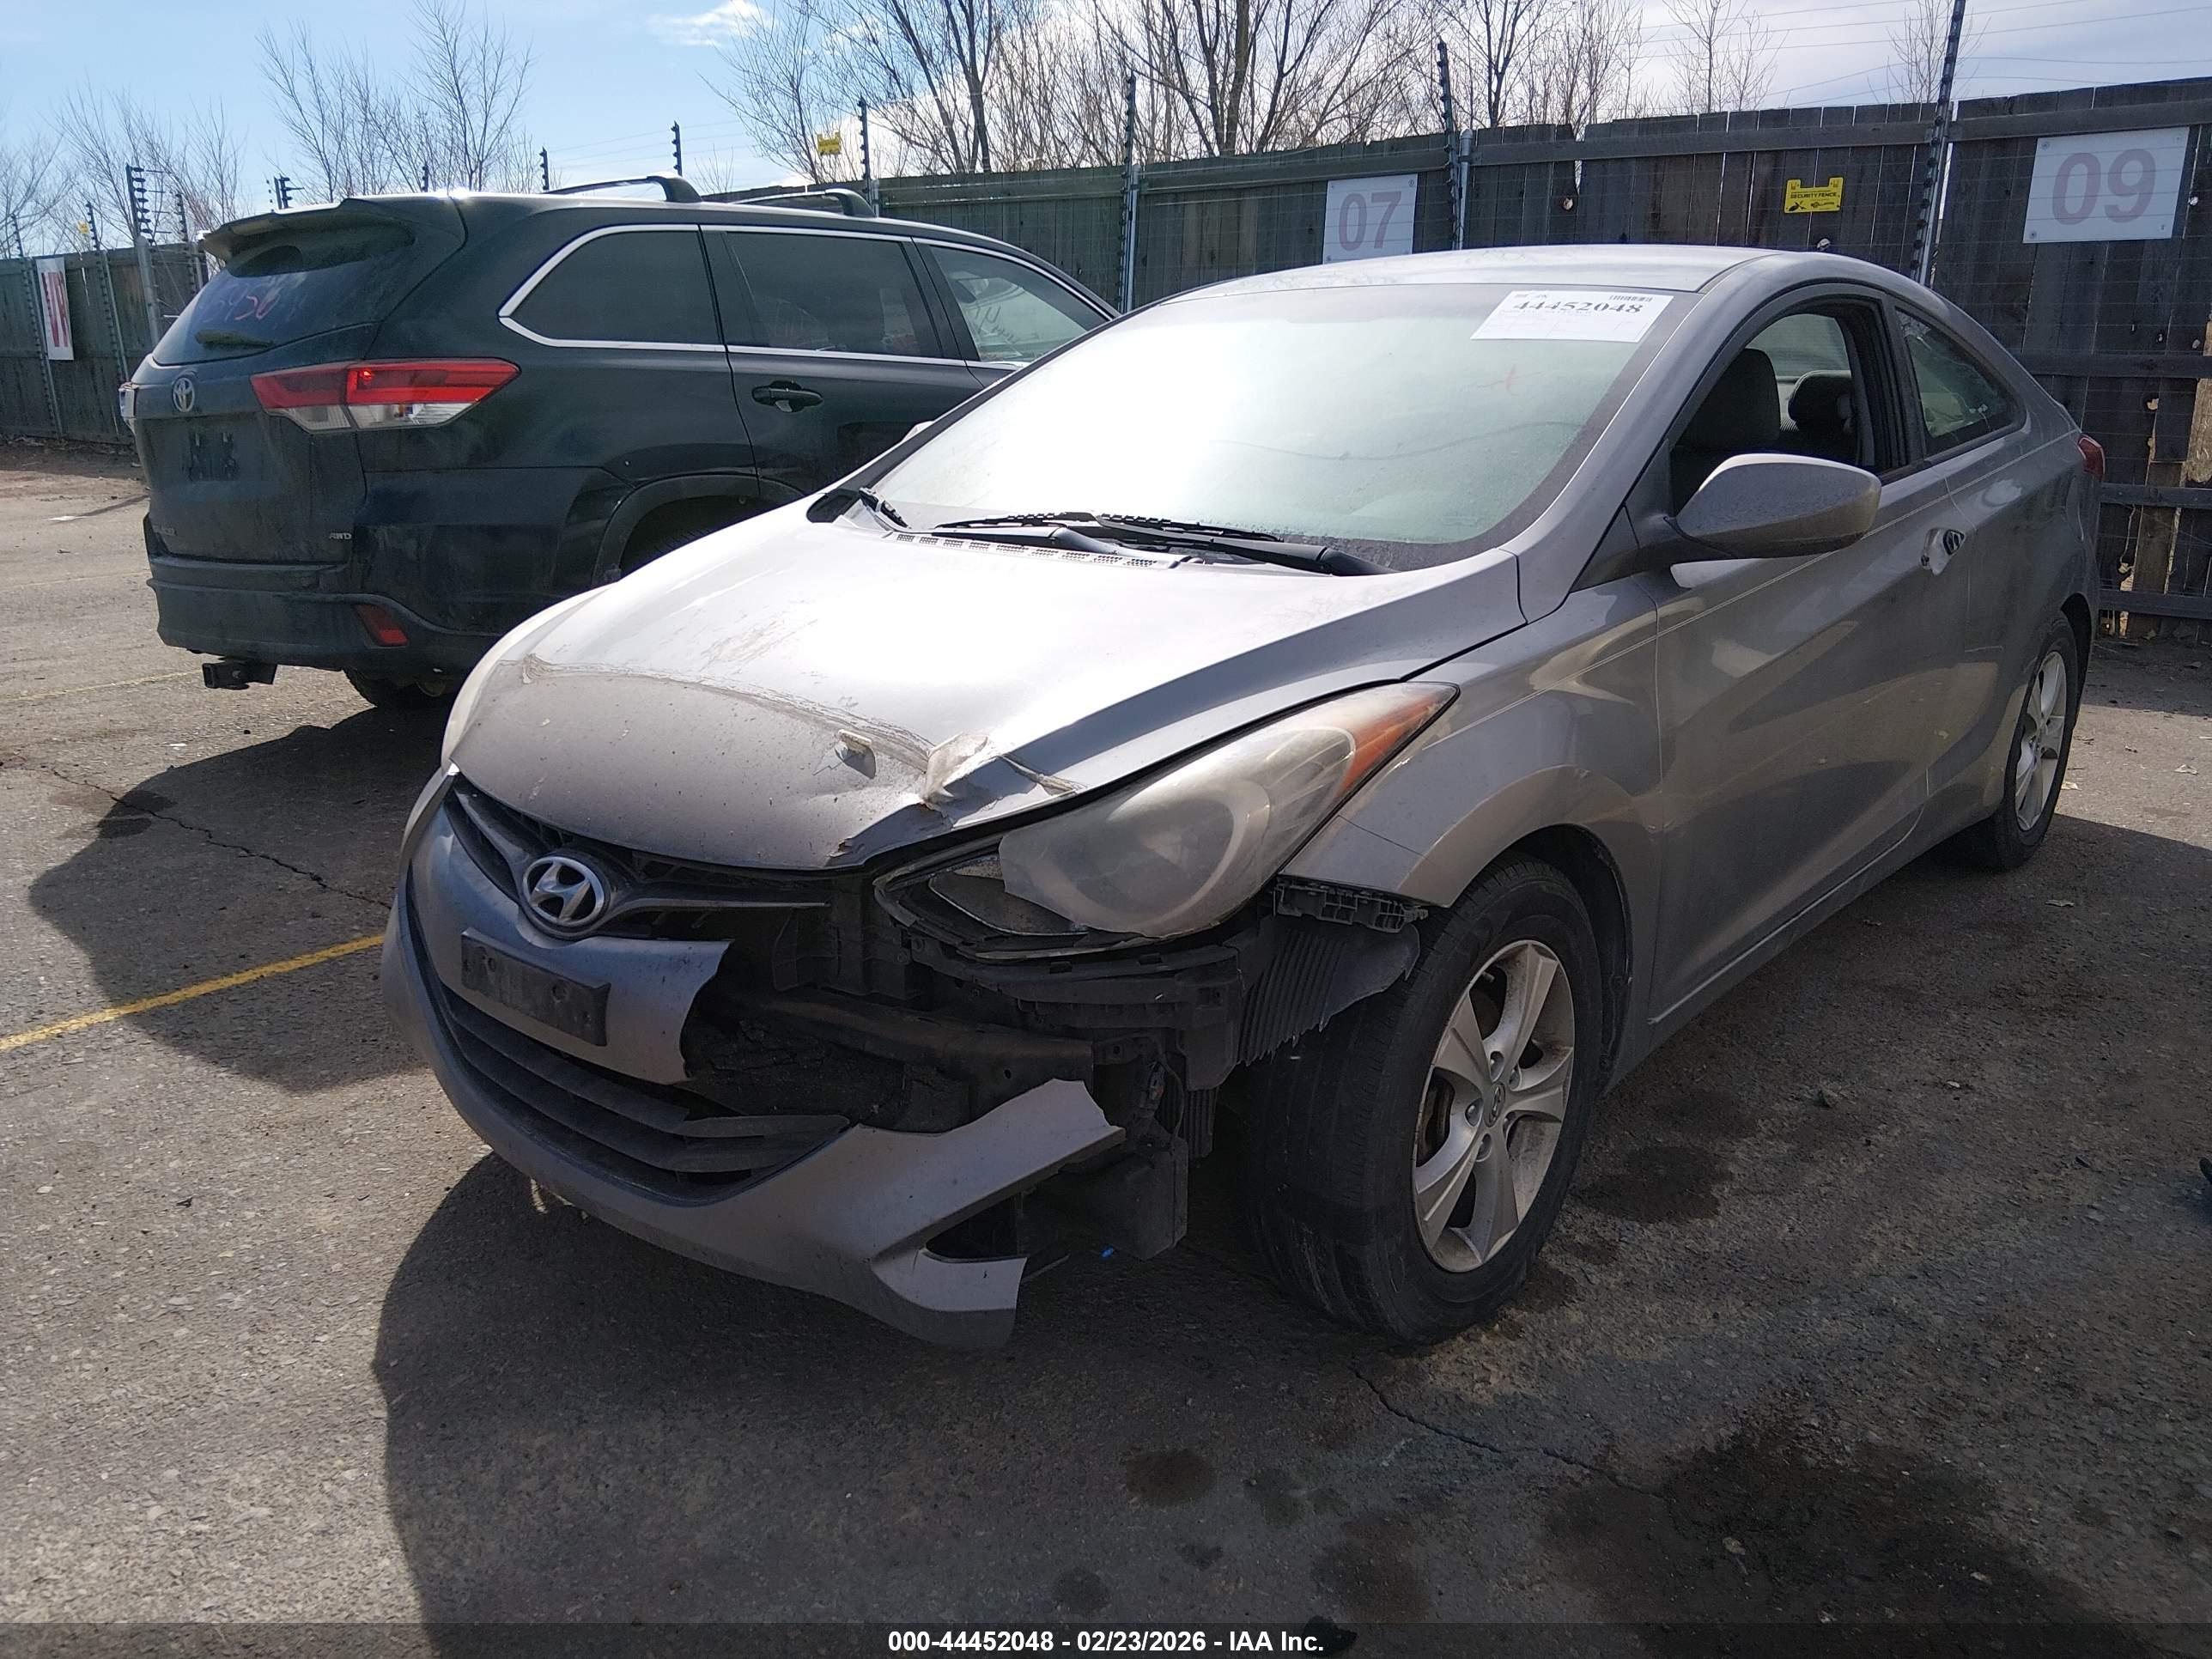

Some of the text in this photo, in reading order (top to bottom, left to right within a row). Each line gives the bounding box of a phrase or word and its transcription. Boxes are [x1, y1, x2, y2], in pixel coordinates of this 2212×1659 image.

[2051, 148, 2157, 226] 09
[1338, 191, 1402, 252] 07
[1512, 301, 1644, 314] 44452048
